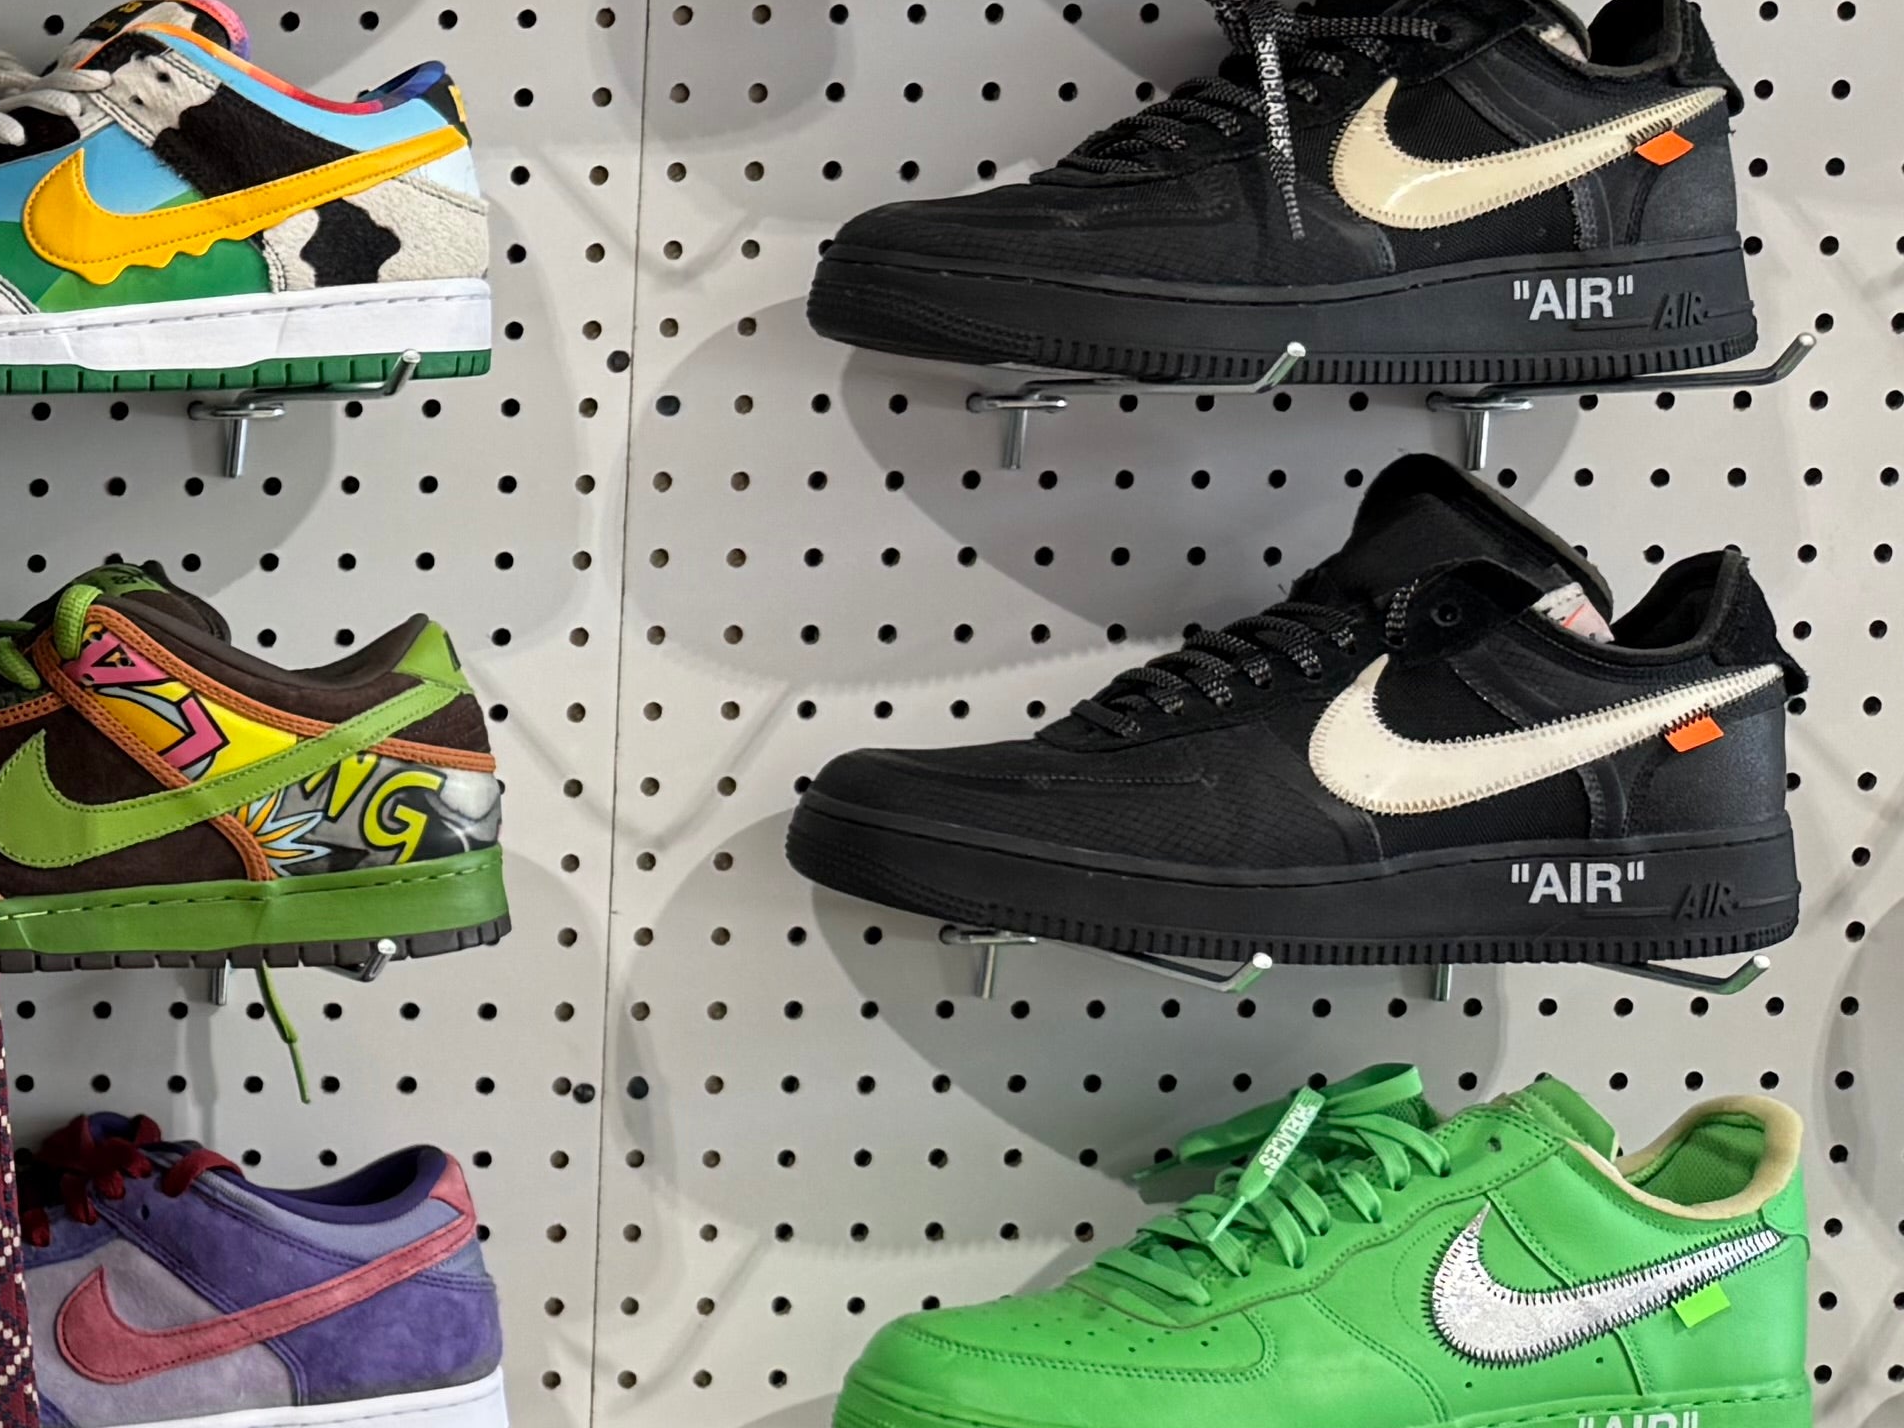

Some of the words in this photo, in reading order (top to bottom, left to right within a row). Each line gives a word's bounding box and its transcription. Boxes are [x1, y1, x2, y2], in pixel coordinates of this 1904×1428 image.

[1513, 274, 1634, 321] "AIR"
[1654, 291, 1709, 330] AIR
[1511, 860, 1645, 904] "AIR"
